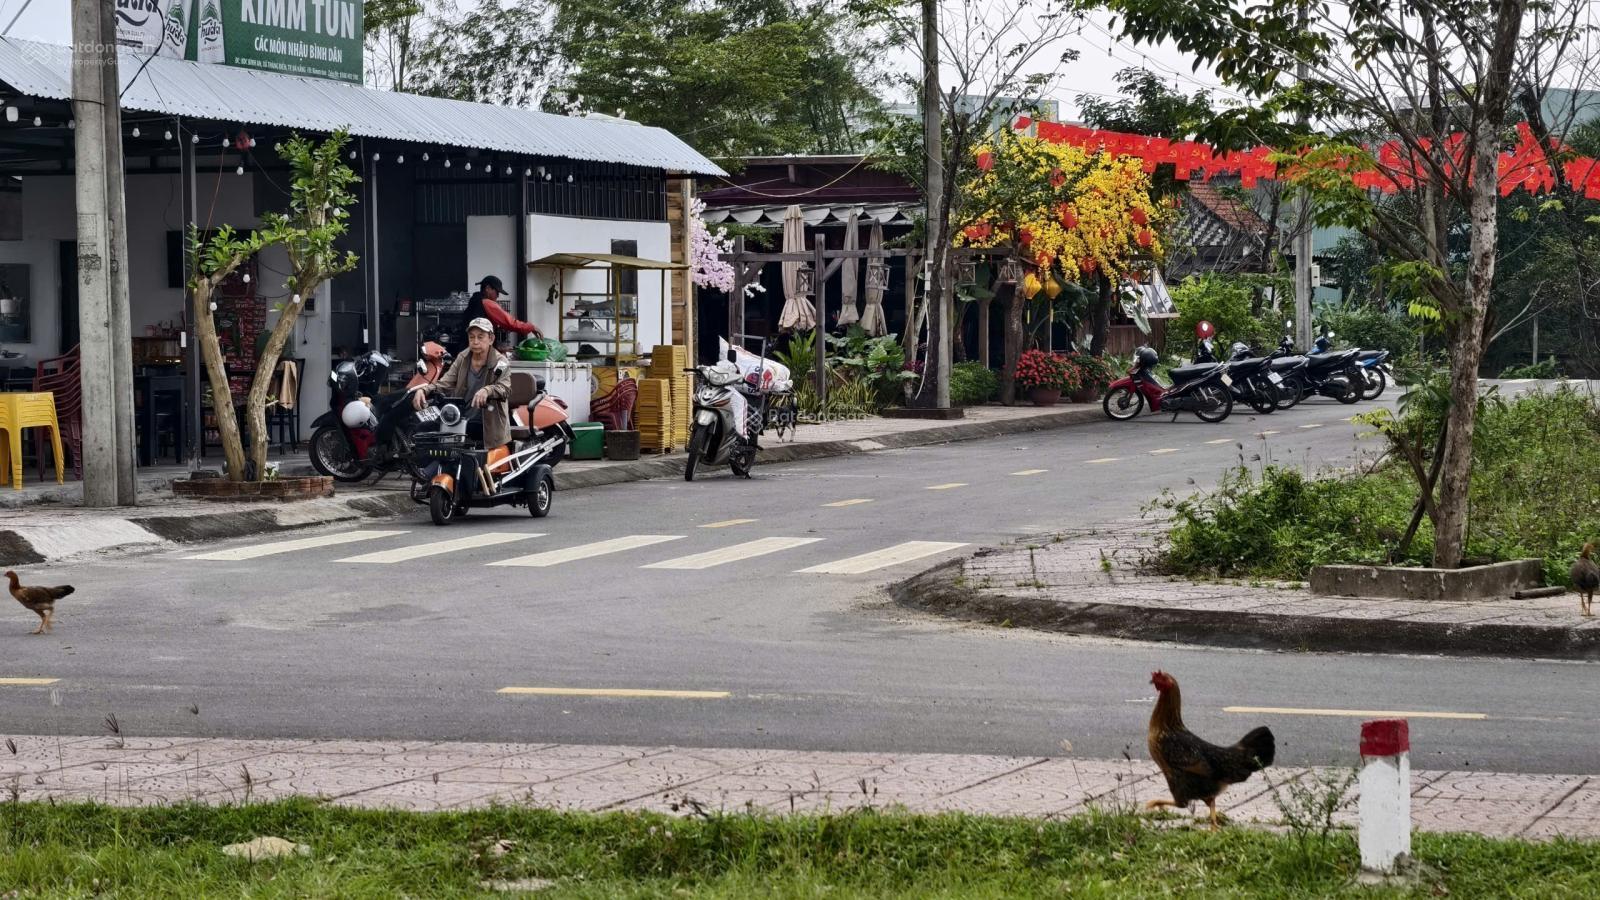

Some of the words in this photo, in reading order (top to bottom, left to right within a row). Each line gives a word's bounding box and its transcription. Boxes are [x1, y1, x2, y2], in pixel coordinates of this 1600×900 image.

[254, 35, 269, 52] CÁC
[269, 38, 287, 55] MÓN
[288, 41, 308, 61] NHẬU
[309, 43, 327, 60] BÌNH
[328, 46, 343, 63] DÂN
